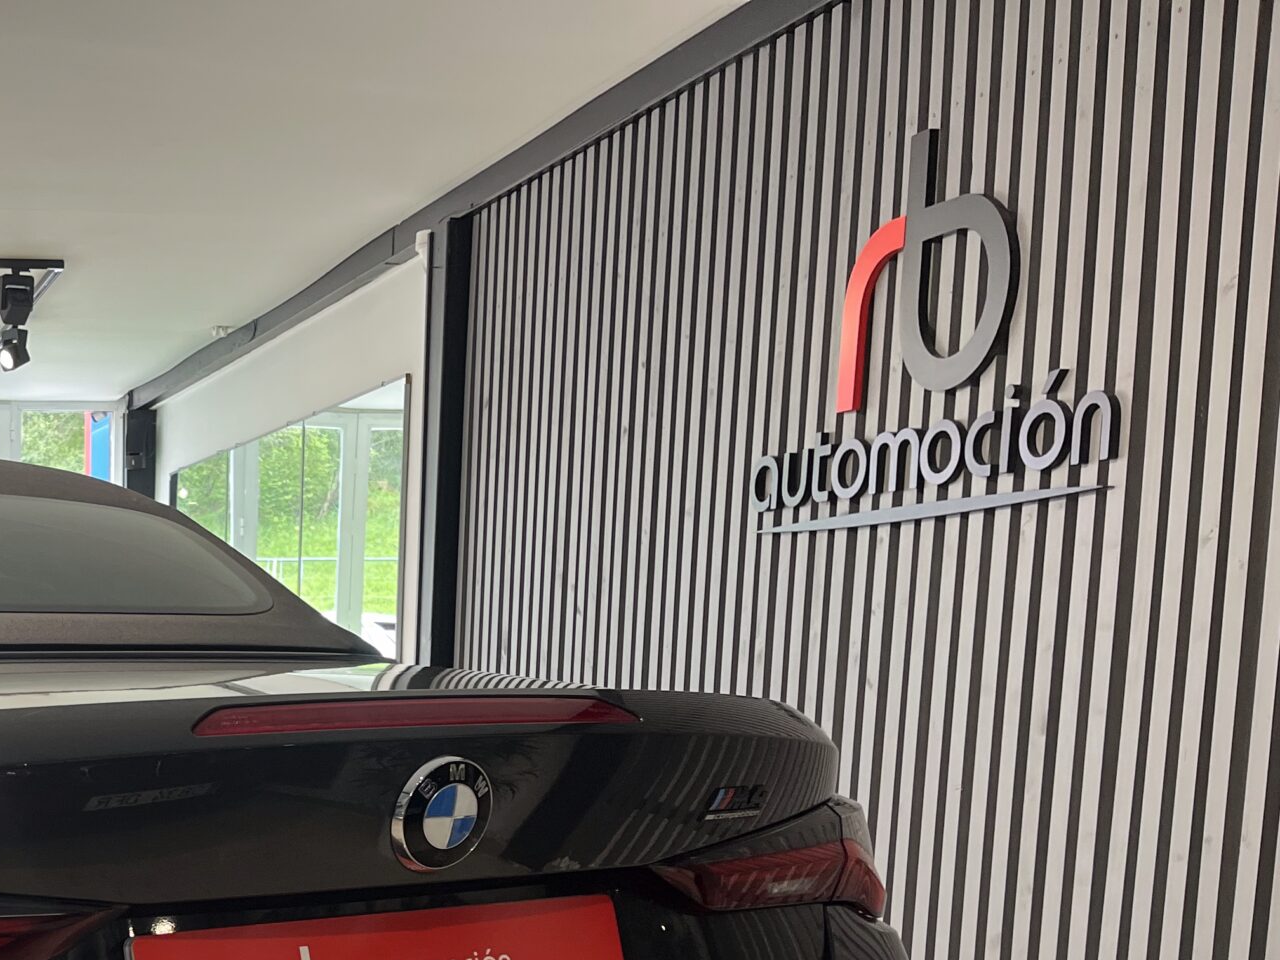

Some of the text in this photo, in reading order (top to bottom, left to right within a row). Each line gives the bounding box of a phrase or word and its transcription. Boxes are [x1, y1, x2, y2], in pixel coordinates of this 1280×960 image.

[836, 128, 1018, 413] rb
[751, 368, 1119, 512] automoción
[418, 763, 489, 799] BMW
